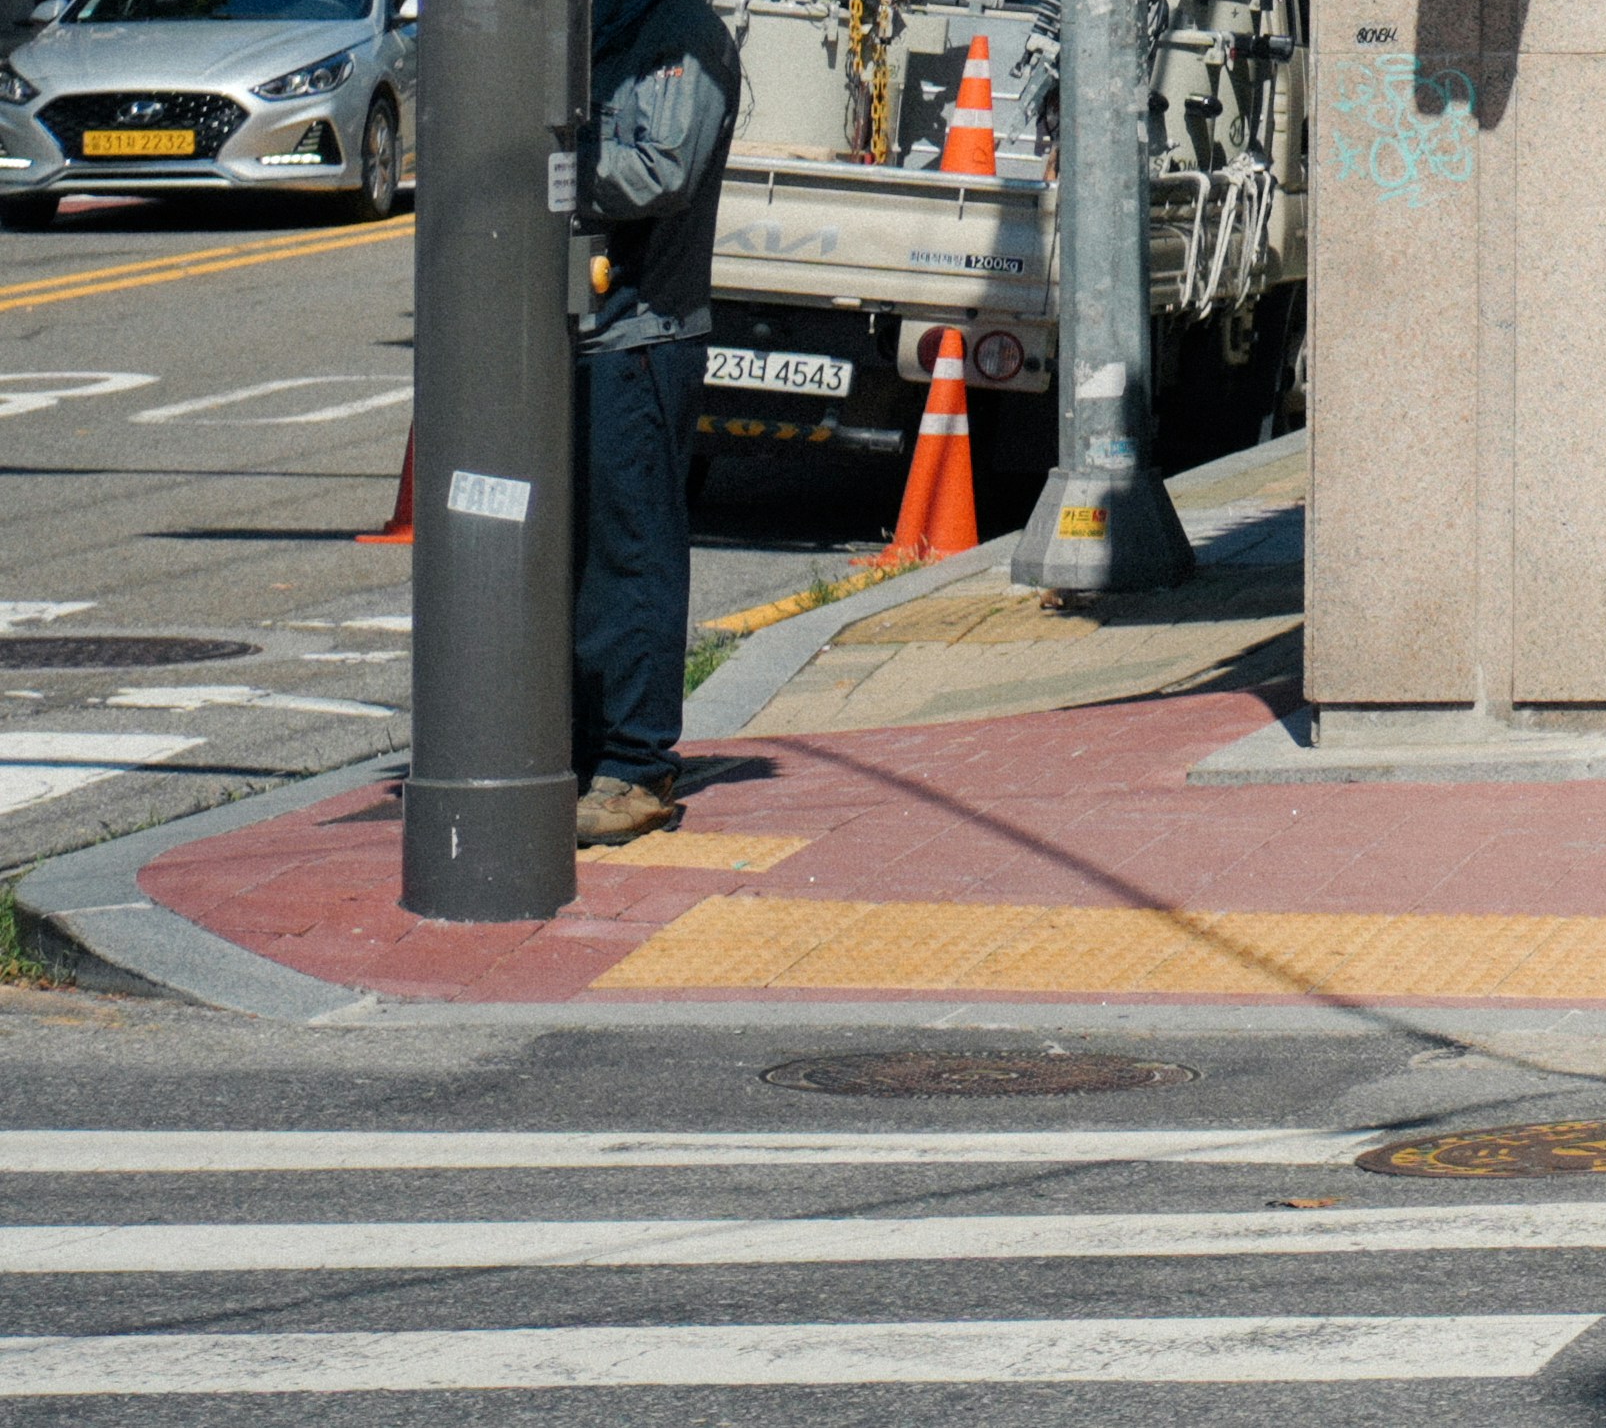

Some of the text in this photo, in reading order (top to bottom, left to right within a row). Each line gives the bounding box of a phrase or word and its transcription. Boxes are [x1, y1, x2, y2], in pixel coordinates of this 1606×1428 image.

[141, 134, 187, 152] 2232
[969, 255, 1020, 273] 1200kg
[706, 352, 844, 392] 23너 4543
